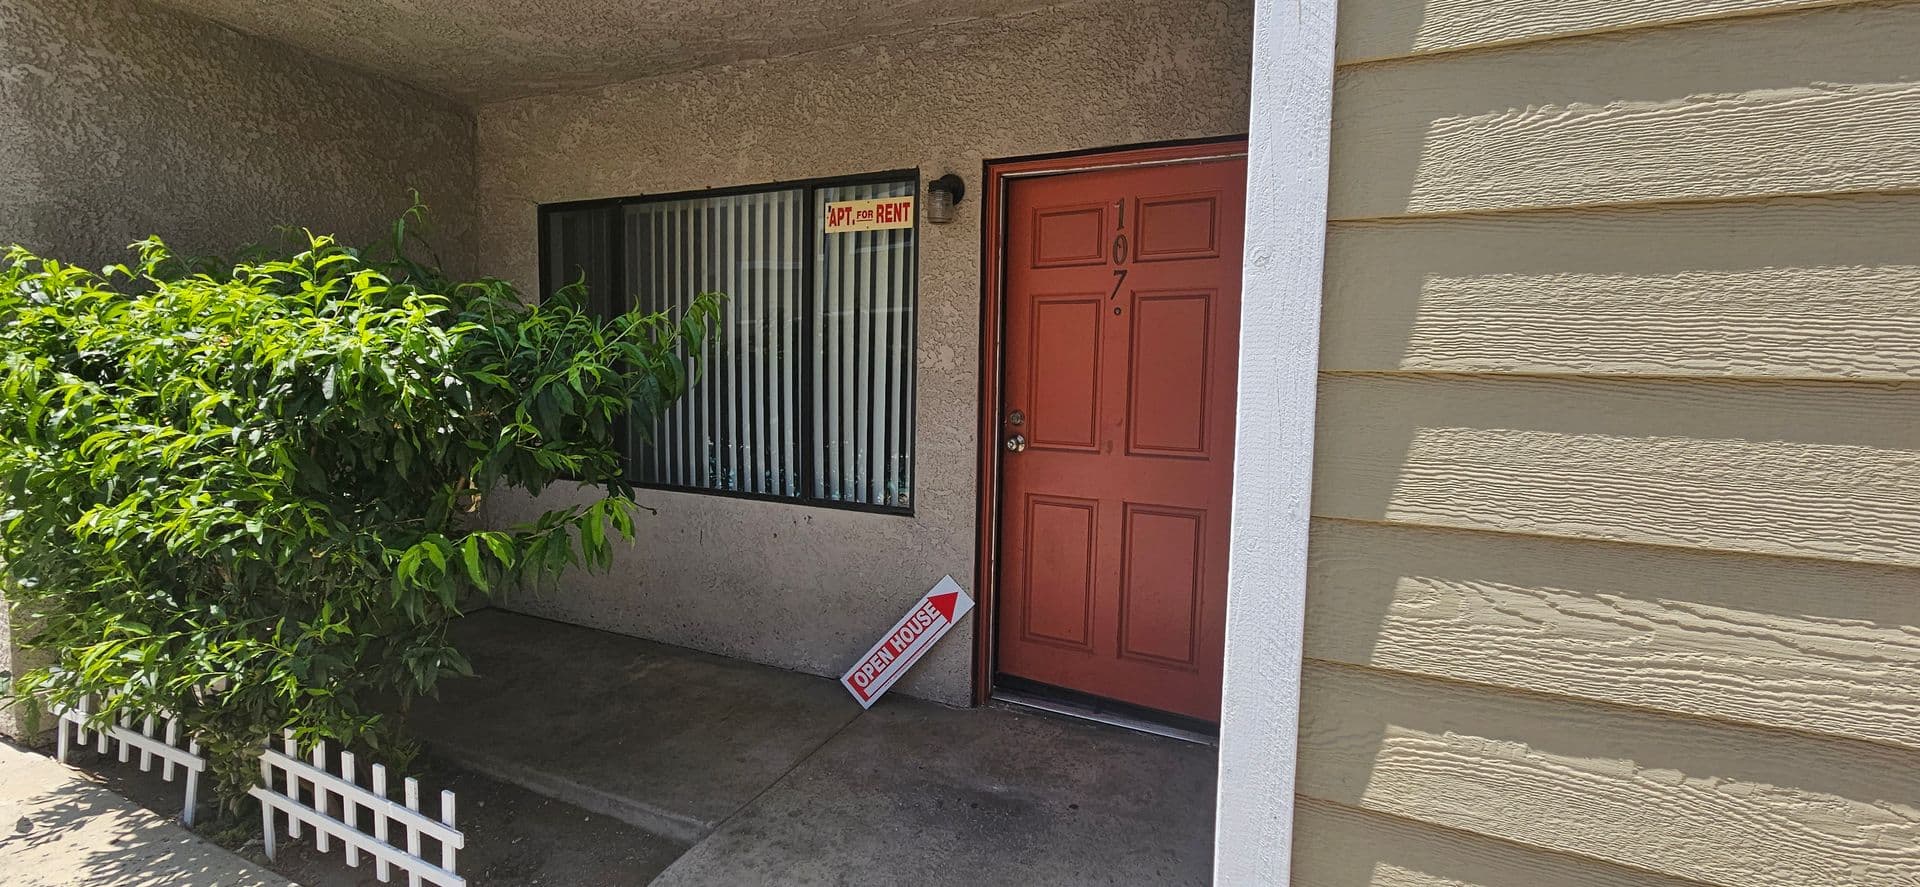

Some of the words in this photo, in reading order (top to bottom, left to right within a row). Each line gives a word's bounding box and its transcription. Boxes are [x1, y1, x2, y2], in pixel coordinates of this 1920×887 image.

[829, 207, 855, 227] APT.
[856, 210, 873, 220] FOR
[876, 202, 910, 224] RENT
[1111, 198, 1128, 300] 107
[854, 646, 895, 687] OPEN
[889, 601, 941, 653] HOUSE
